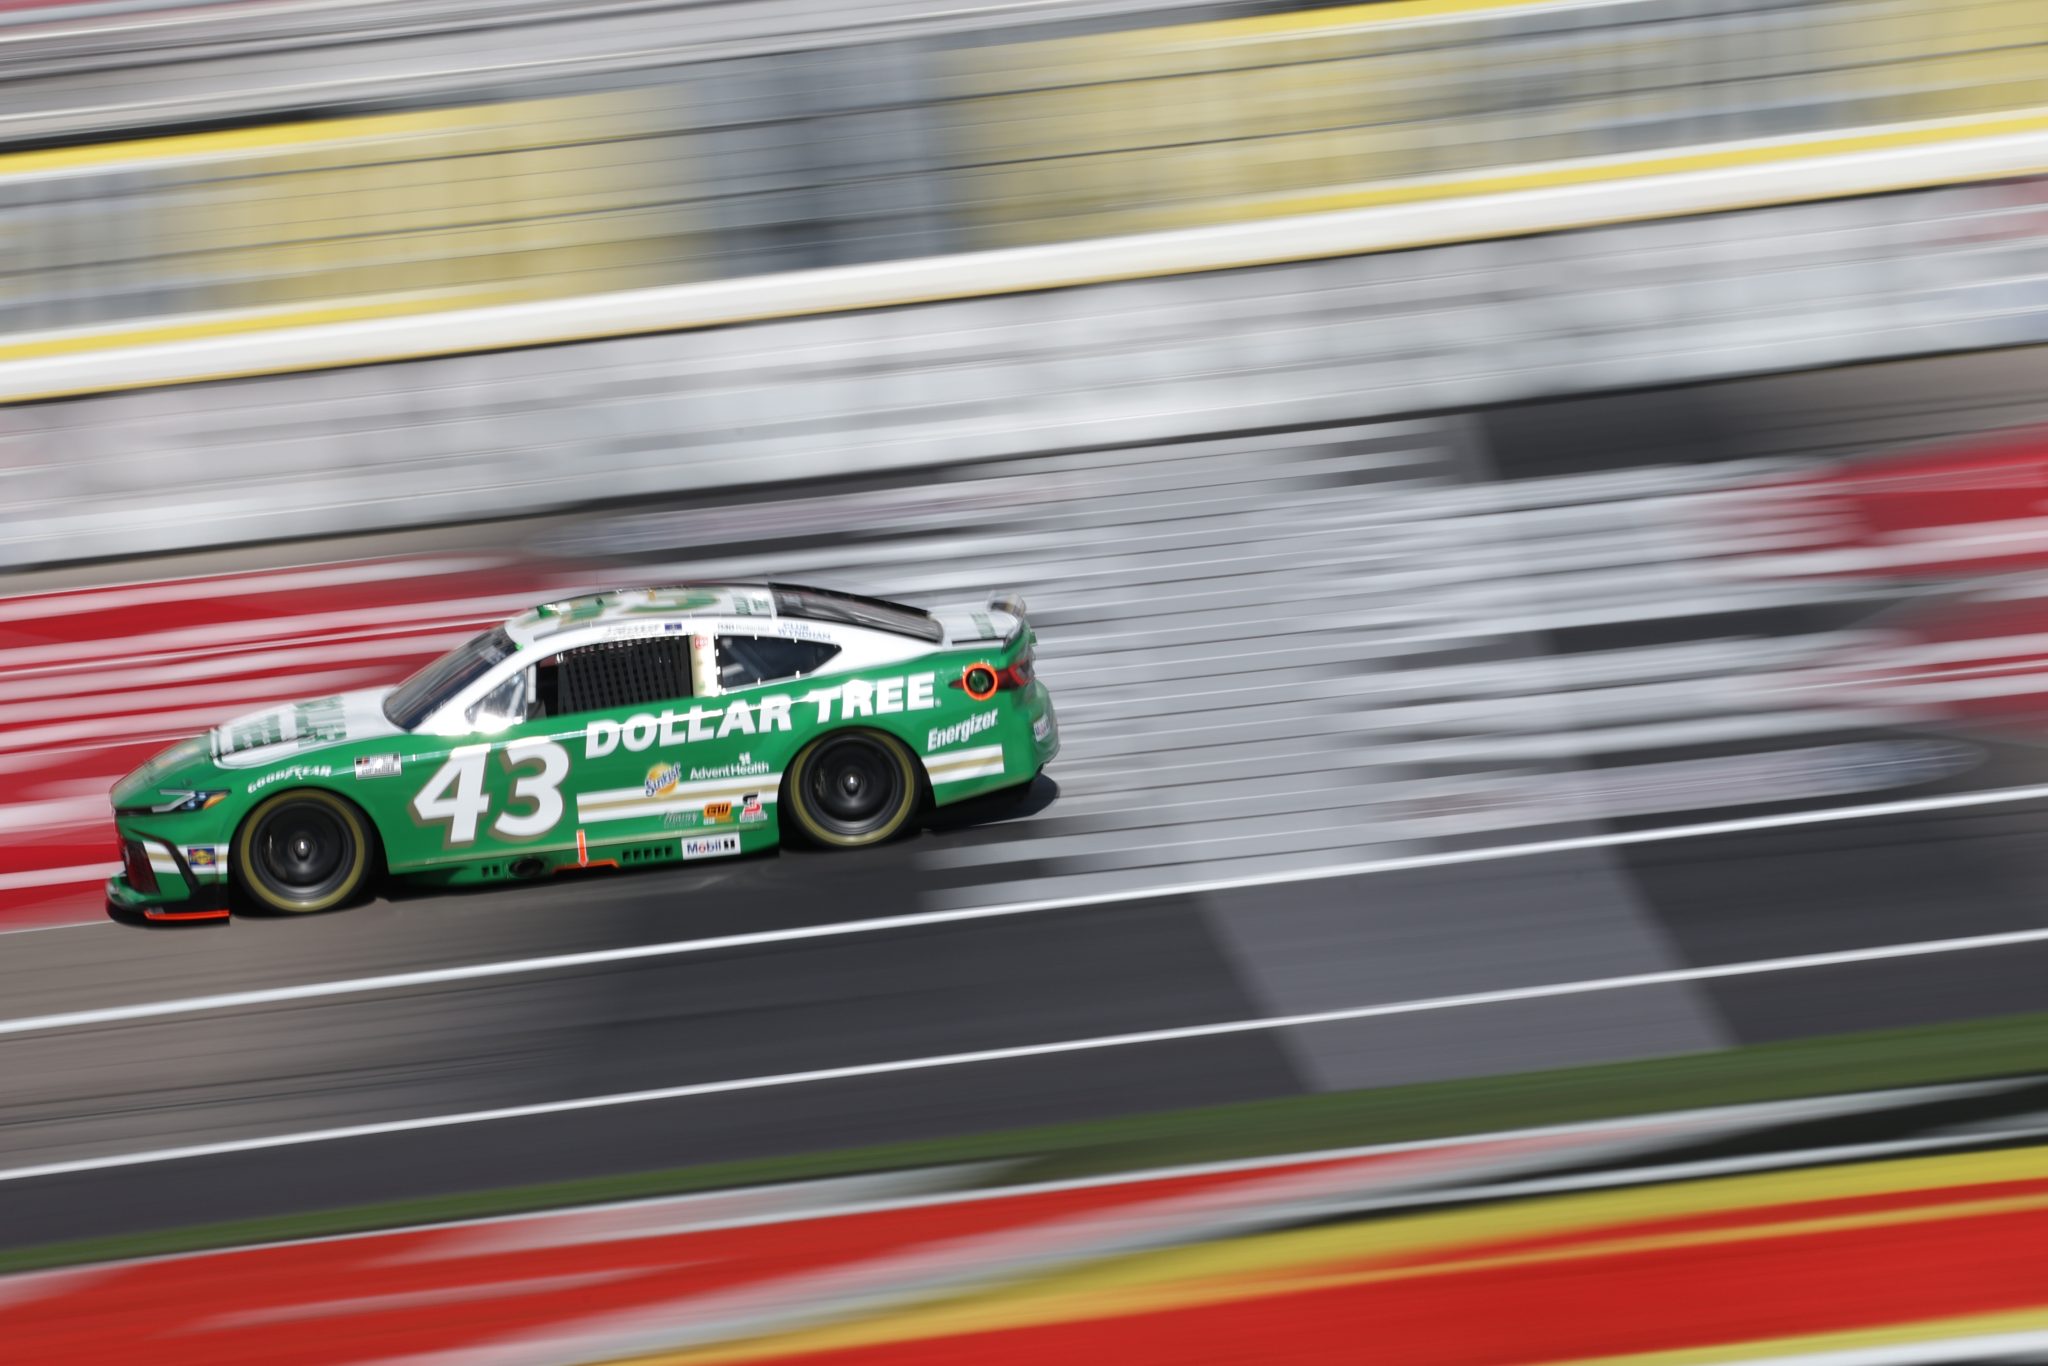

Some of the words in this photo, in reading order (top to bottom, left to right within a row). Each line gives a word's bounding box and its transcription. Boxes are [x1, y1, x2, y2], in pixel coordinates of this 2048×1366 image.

[778, 629, 832, 641] WYNDHAM
[585, 693, 793, 759] DOLLAR
[806, 672, 936, 723] TREE
[927, 708, 998, 752] Energizer
[247, 765, 332, 794] GOODYEAR
[645, 762, 682, 797] Sunkist
[690, 762, 770, 780] AdventHealth
[412, 736, 570, 844] 43
[686, 841, 721, 854] Mobil
